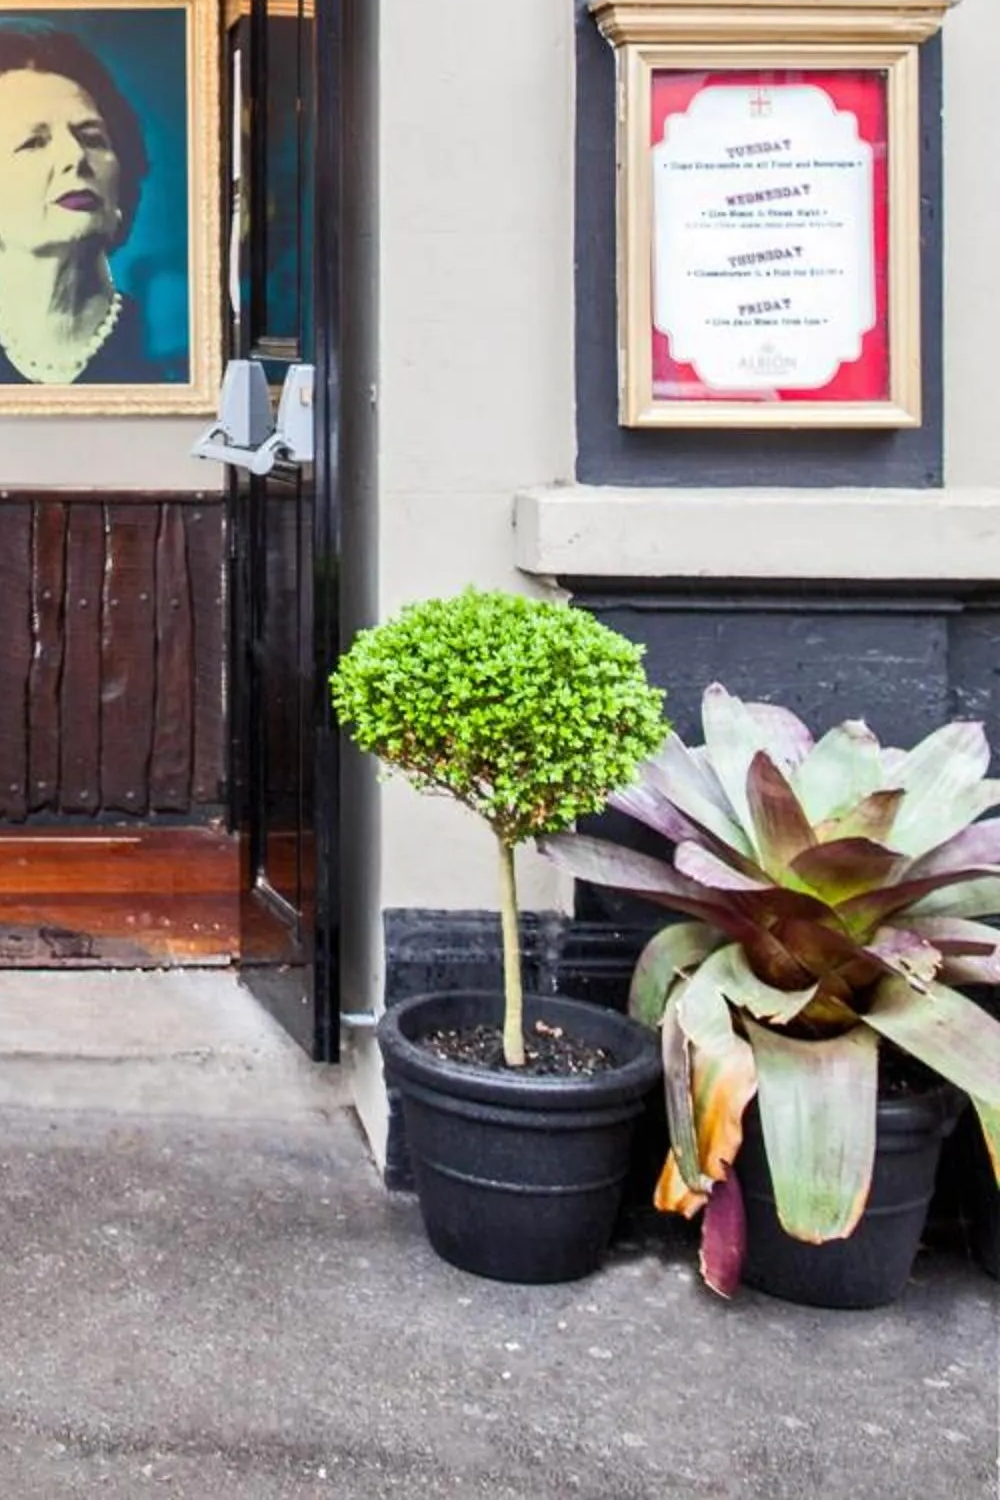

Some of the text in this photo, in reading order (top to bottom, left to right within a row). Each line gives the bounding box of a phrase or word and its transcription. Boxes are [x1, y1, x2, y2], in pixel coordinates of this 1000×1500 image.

[725, 138, 792, 158] TUESDAY
[725, 183, 811, 206] WEDNESDAY
[727, 245, 803, 268] THURSDAY
[738, 297, 792, 316] FRIDAY
